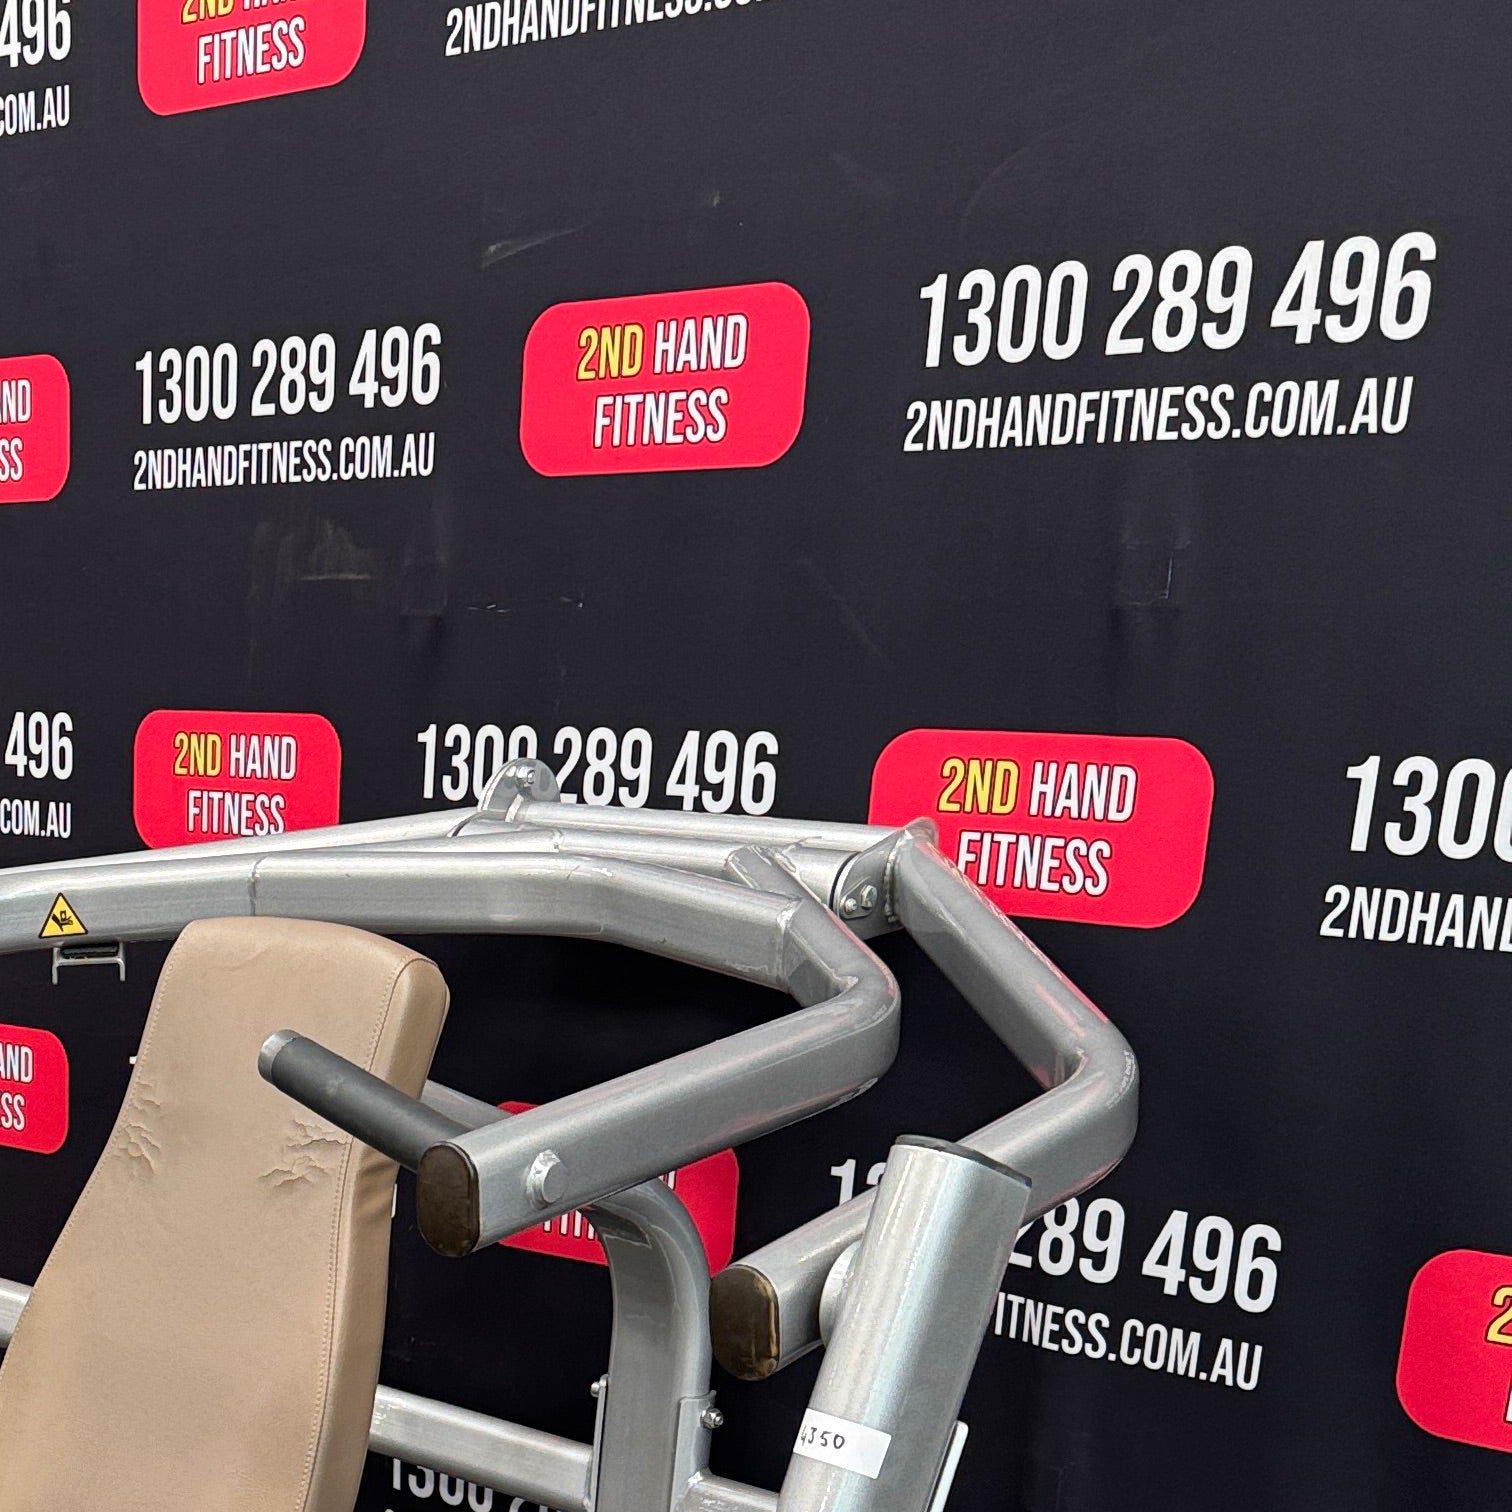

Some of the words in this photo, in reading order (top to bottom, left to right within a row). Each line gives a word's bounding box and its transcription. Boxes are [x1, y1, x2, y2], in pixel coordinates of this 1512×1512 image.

[198, 16, 305, 84] FITNESS
[919, 260, 1088, 368] 1300
[1105, 245, 1253, 356] 289
[1270, 231, 1437, 345] 496
[135, 342, 238, 425] 1300
[250, 332, 336, 418] 289
[348, 322, 442, 410] 496
[577, 324, 642, 381] 2ND
[653, 313, 748, 375] HAND
[593, 387, 728, 448] FITNESS
[903, 375, 1414, 452] 2NDHANDFITNESS.COM.AU
[133, 431, 435, 491] 2NDHANDFITNESS.COM.AU
[4, 712, 73, 780] 496
[174, 731, 222, 778] 2ND
[228, 733, 296, 781] HAND
[551, 726, 653, 809] 289
[666, 730, 779, 815] 496
[187, 789, 285, 837] FITNESS
[938, 758, 1019, 816] 2ND
[1029, 761, 1137, 822] HAND
[958, 831, 1112, 897] FITNESS
[1141, 1209, 1282, 1313] 496
